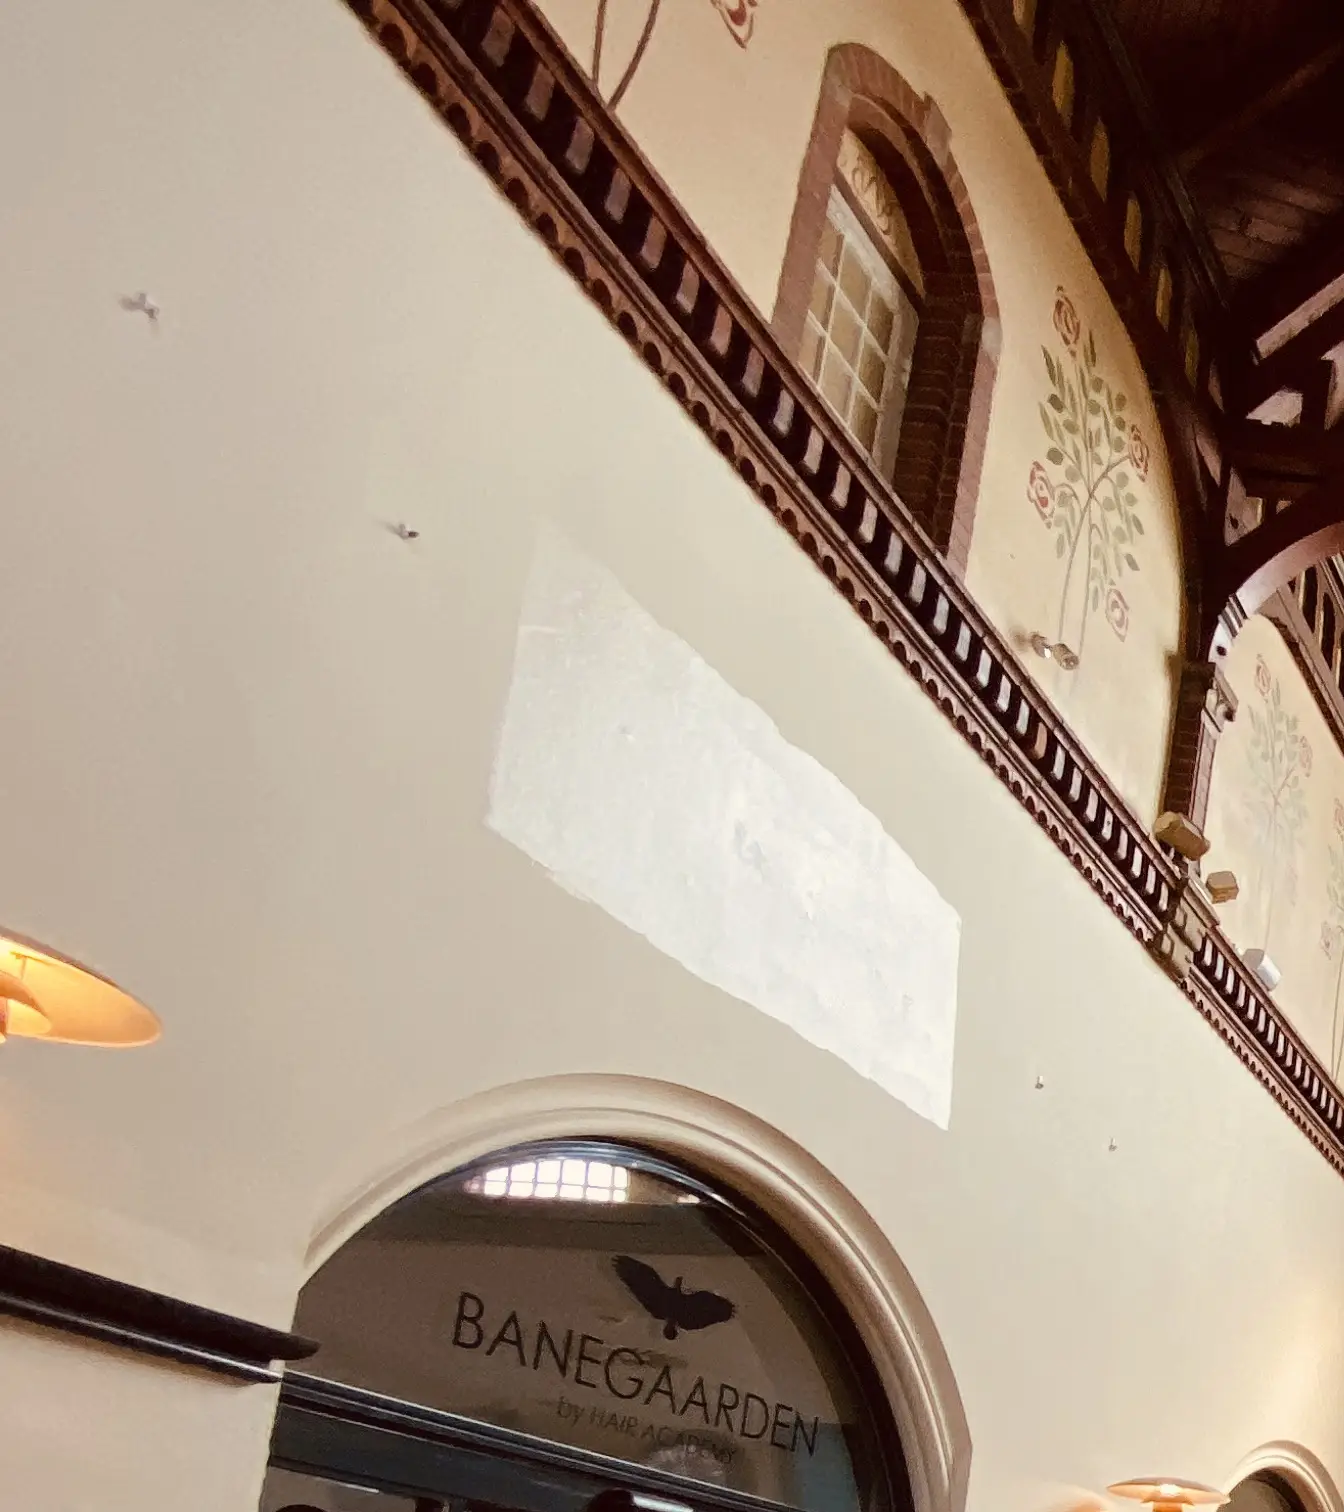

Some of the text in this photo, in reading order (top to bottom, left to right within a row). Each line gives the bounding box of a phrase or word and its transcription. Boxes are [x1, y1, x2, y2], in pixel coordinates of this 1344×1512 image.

[452, 1291, 819, 1457] BANEGAARDEN
[557, 1397, 584, 1426] by
[589, 1408, 639, 1438] HAIR
